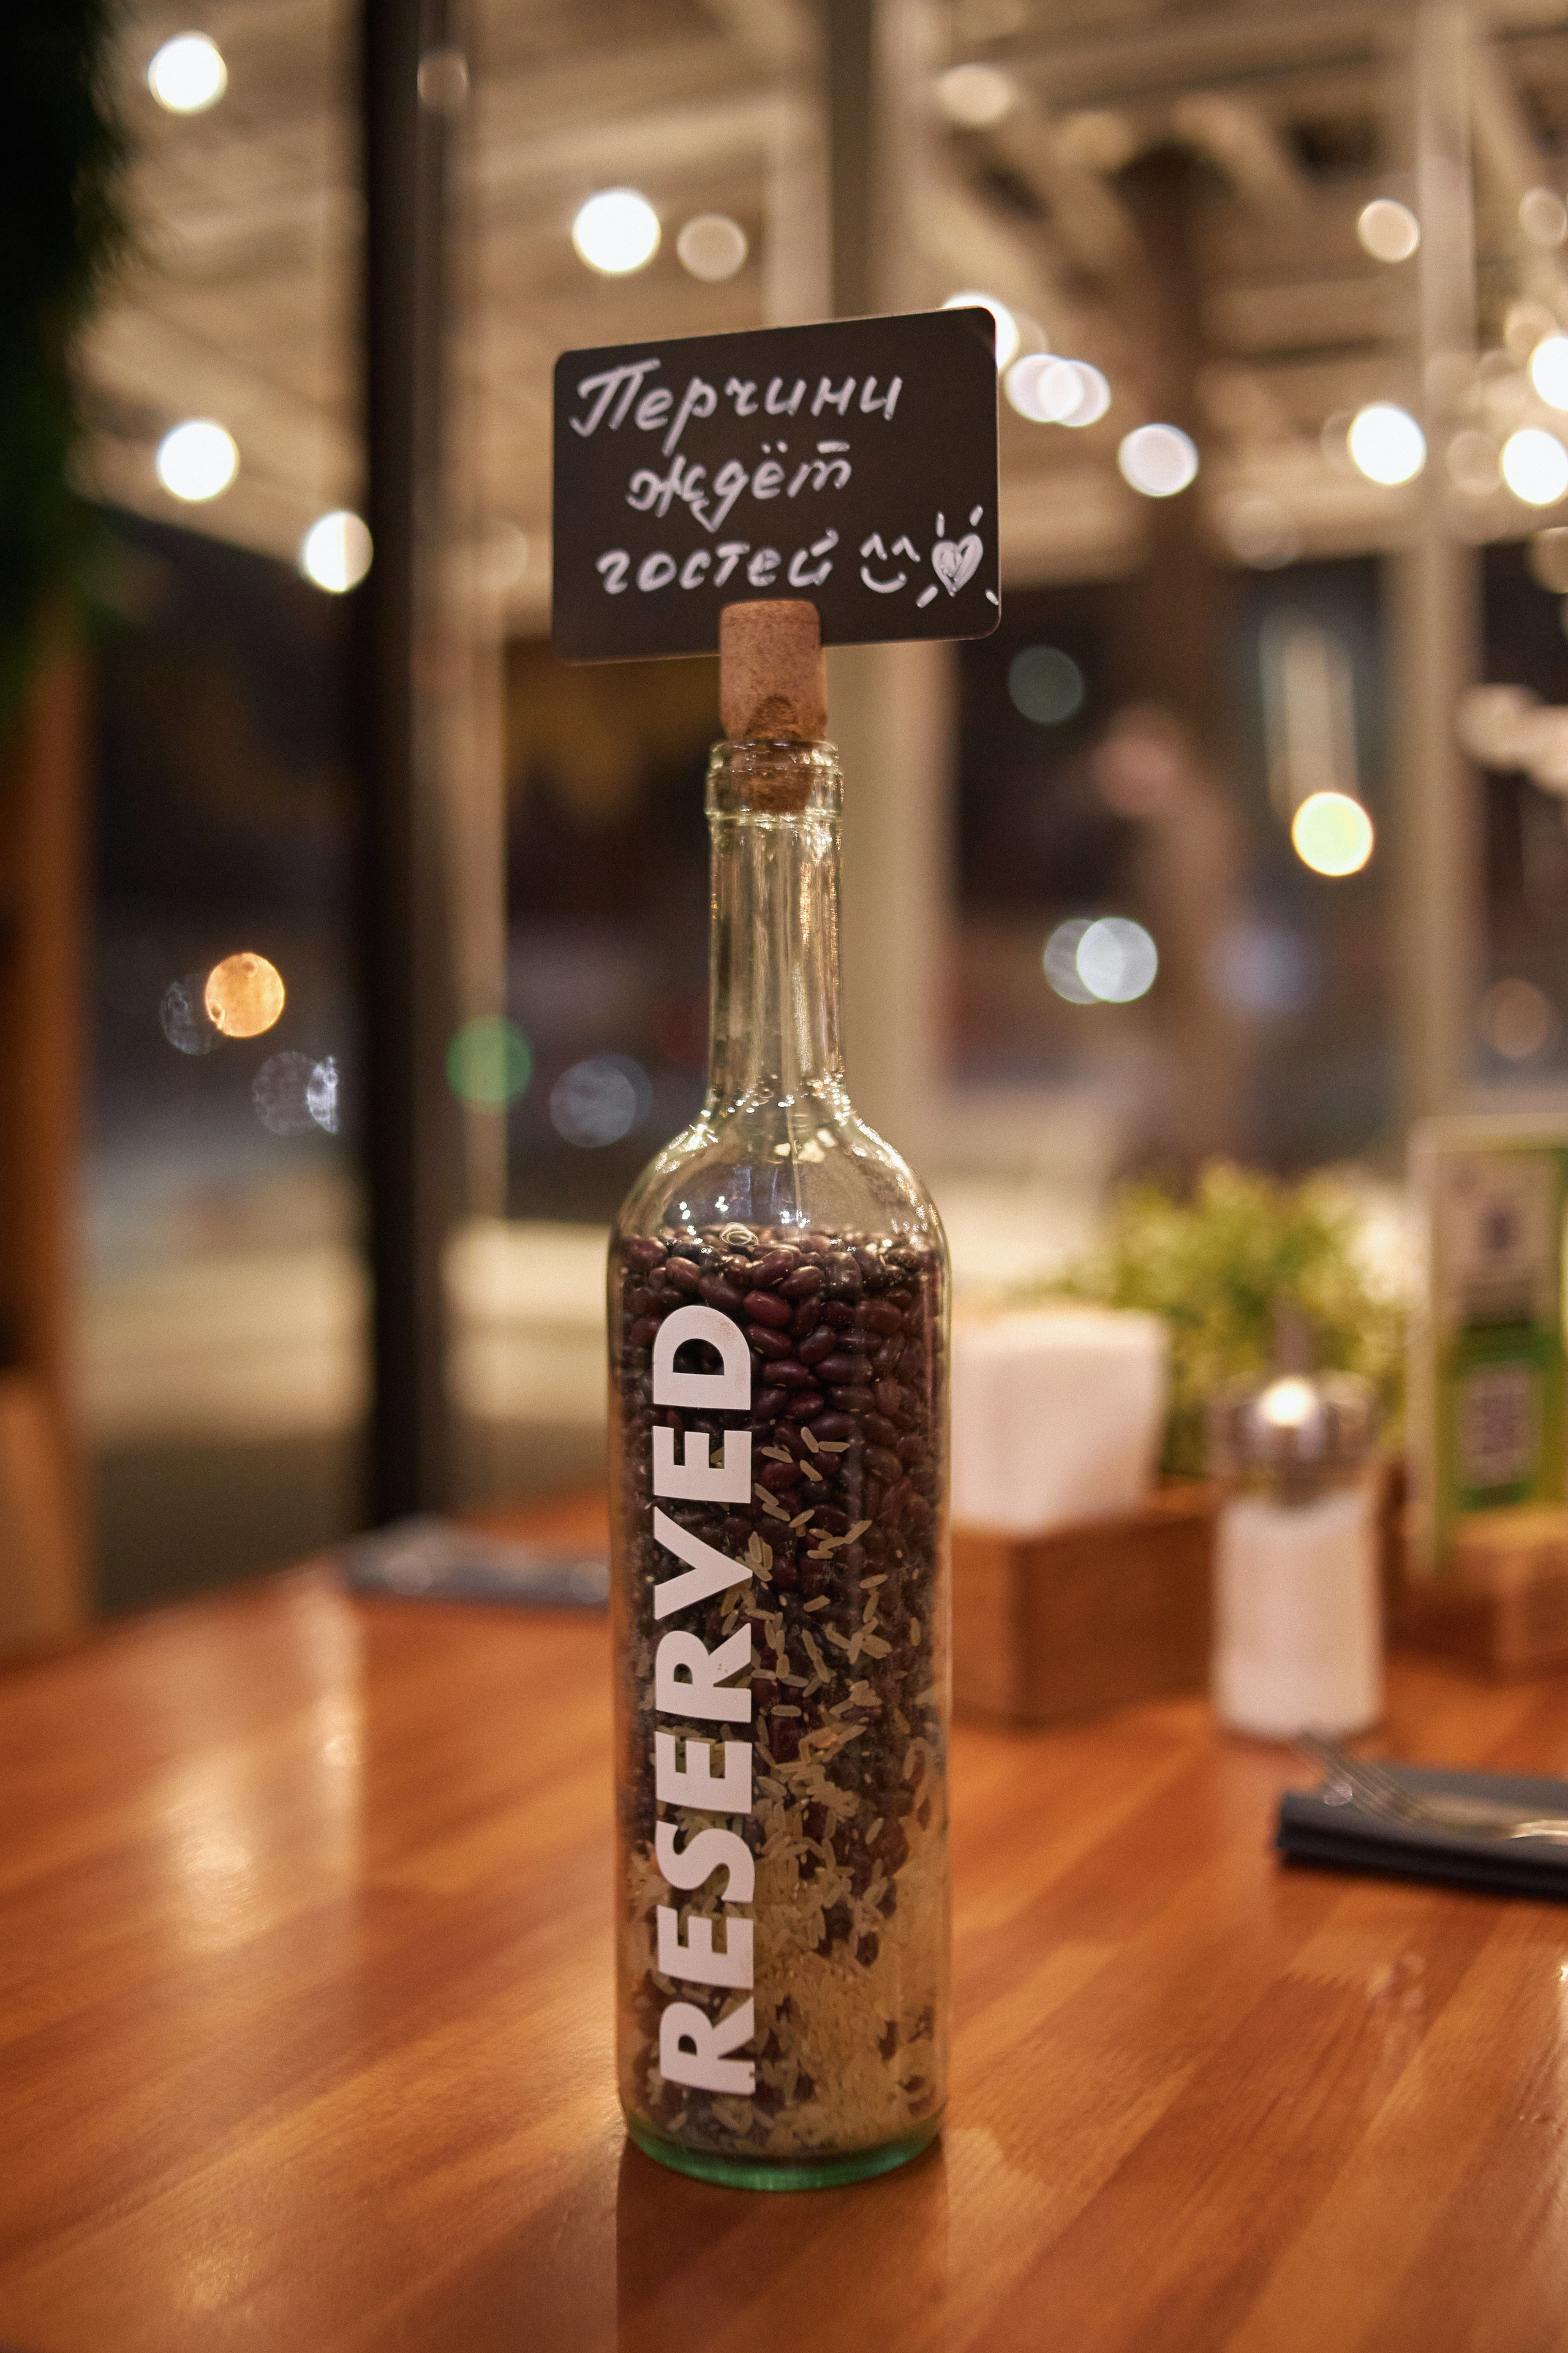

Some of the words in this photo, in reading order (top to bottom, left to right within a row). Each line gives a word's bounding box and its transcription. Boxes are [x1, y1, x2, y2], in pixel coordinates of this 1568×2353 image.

[570, 358, 902, 456] Перчини
[626, 440, 852, 532] ждёт
[596, 528, 839, 594] гостей
[653, 1305, 756, 2095] RESERVED
